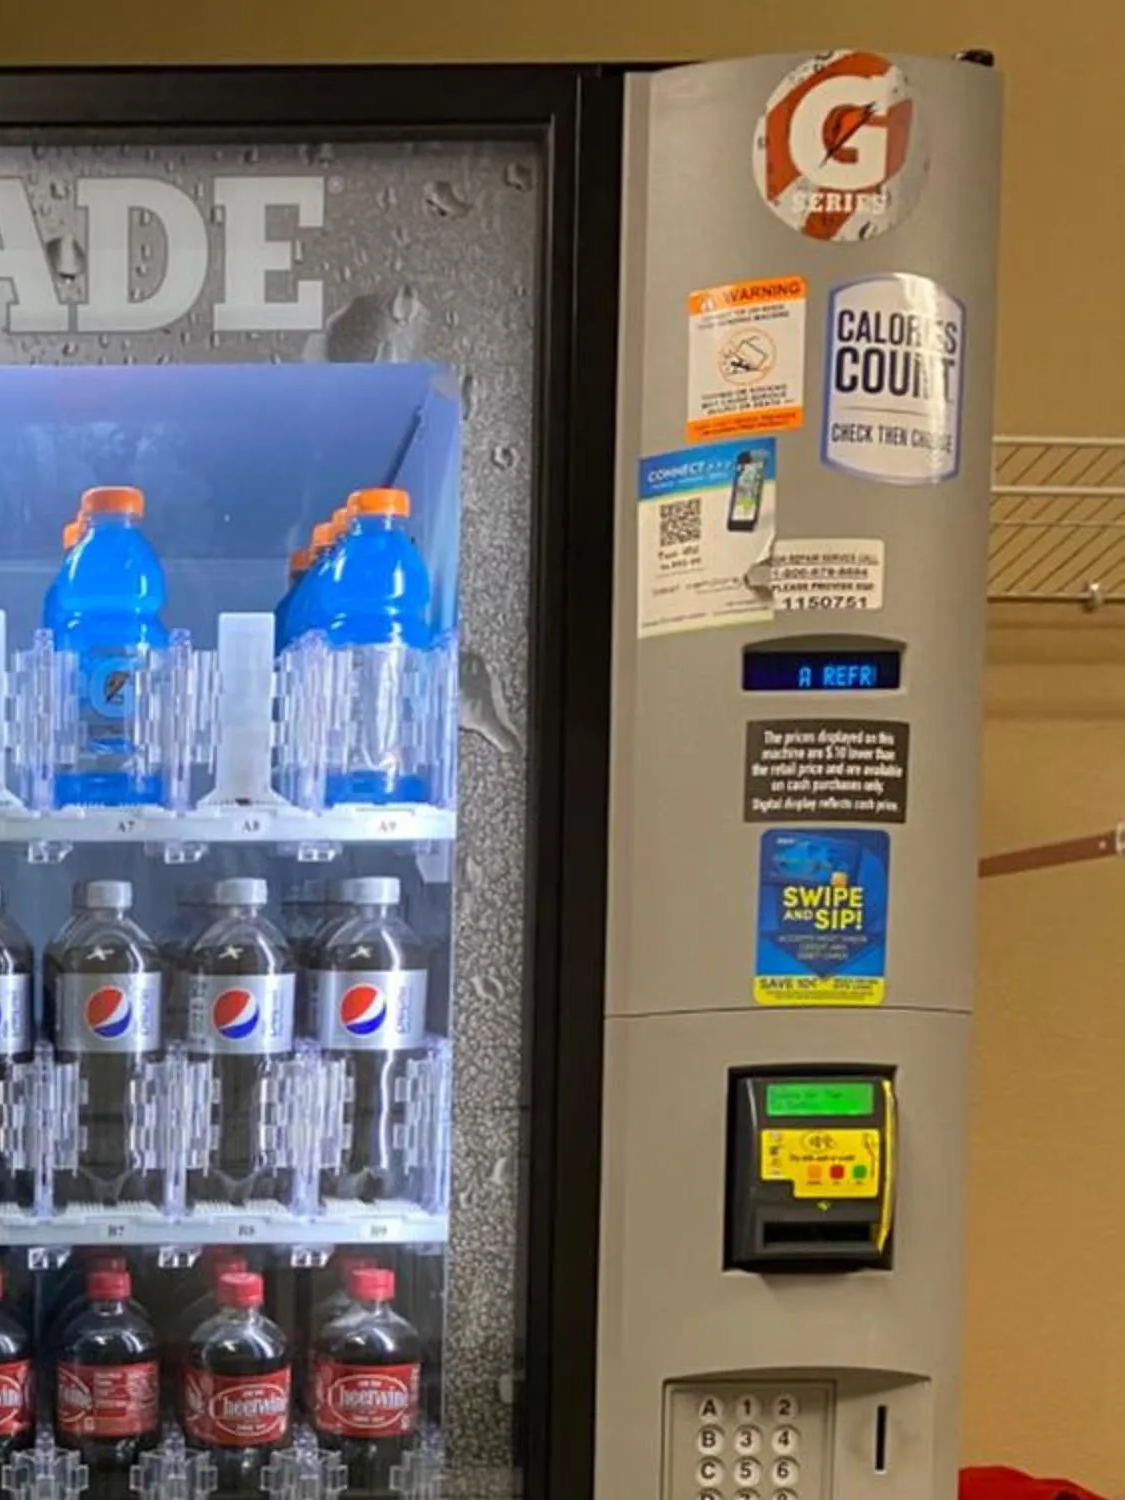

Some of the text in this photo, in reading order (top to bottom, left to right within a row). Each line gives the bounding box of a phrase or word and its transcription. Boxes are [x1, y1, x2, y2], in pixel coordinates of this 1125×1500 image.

[791, 192, 888, 213] SERIES
[725, 281, 801, 302] WARNING
[831, 423, 873, 442] CHECK
[878, 424, 908, 446] THEN
[783, 596, 867, 609] 1150751
[798, 665, 811, 687] A
[764, 730, 782, 745] The
[818, 730, 863, 747] displayed
[761, 747, 805, 760] machine
[807, 749, 823, 760] are
[875, 748, 896, 761] than
[751, 763, 903, 778] the retail price and are available
[771, 780, 784, 792] on
[786, 779, 811, 791] cash
[812, 779, 861, 793] purchases
[784, 798, 816, 812] display
[854, 799, 874, 810] cash
[783, 886, 864, 908] SWIPE
[783, 909, 863, 931] AND SIP!
[702, 1400, 791, 1416] A 1 2
[702, 1431, 790, 1447] B 3 4
[701, 1462, 789, 1479] C 5 6
